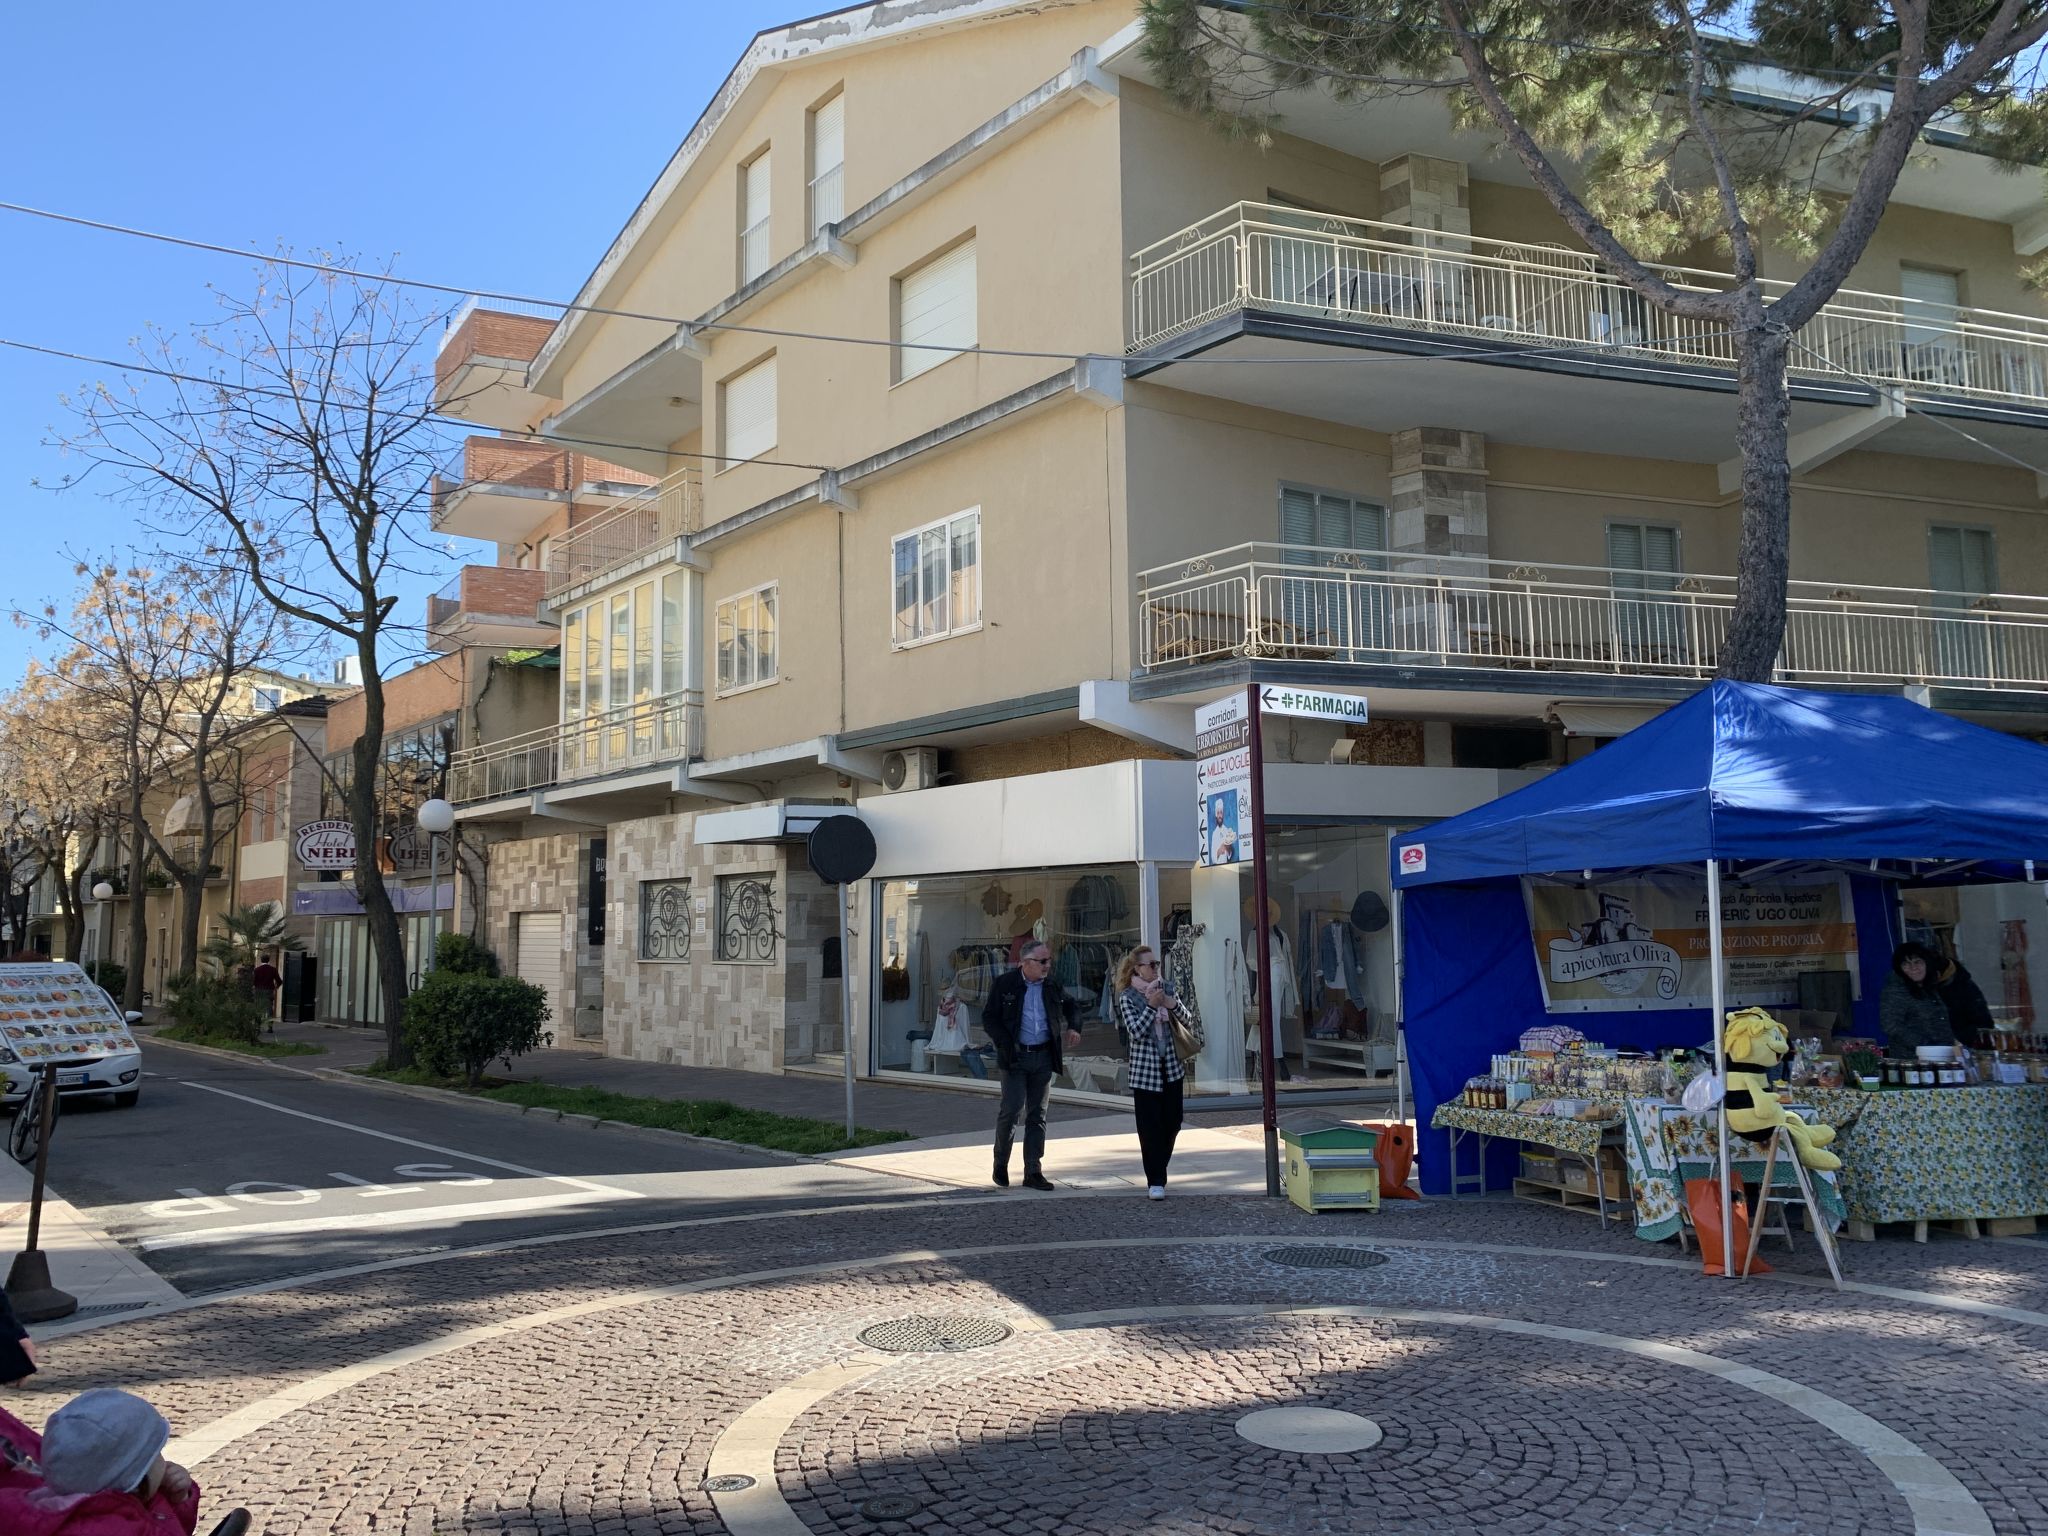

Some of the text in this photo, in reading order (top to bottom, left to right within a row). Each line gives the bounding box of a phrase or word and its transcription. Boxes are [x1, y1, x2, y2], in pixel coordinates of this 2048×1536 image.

[1207, 704, 1238, 728] corridoni
[1295, 693, 1367, 718] FARMACIA
[1197, 722, 1240, 751] ERBORISTERIA
[306, 832, 352, 848] Hotel
[307, 847, 357, 858] NERI
[1738, 892, 1782, 906] Agricola
[1755, 907, 1786, 921] UGO
[1788, 906, 1822, 920] OLIVA
[1688, 932, 1825, 950] PROUZIONE PROPRIA
[1561, 943, 1672, 978] apicoltura Oliva
[142, 1162, 494, 1218] STOP
